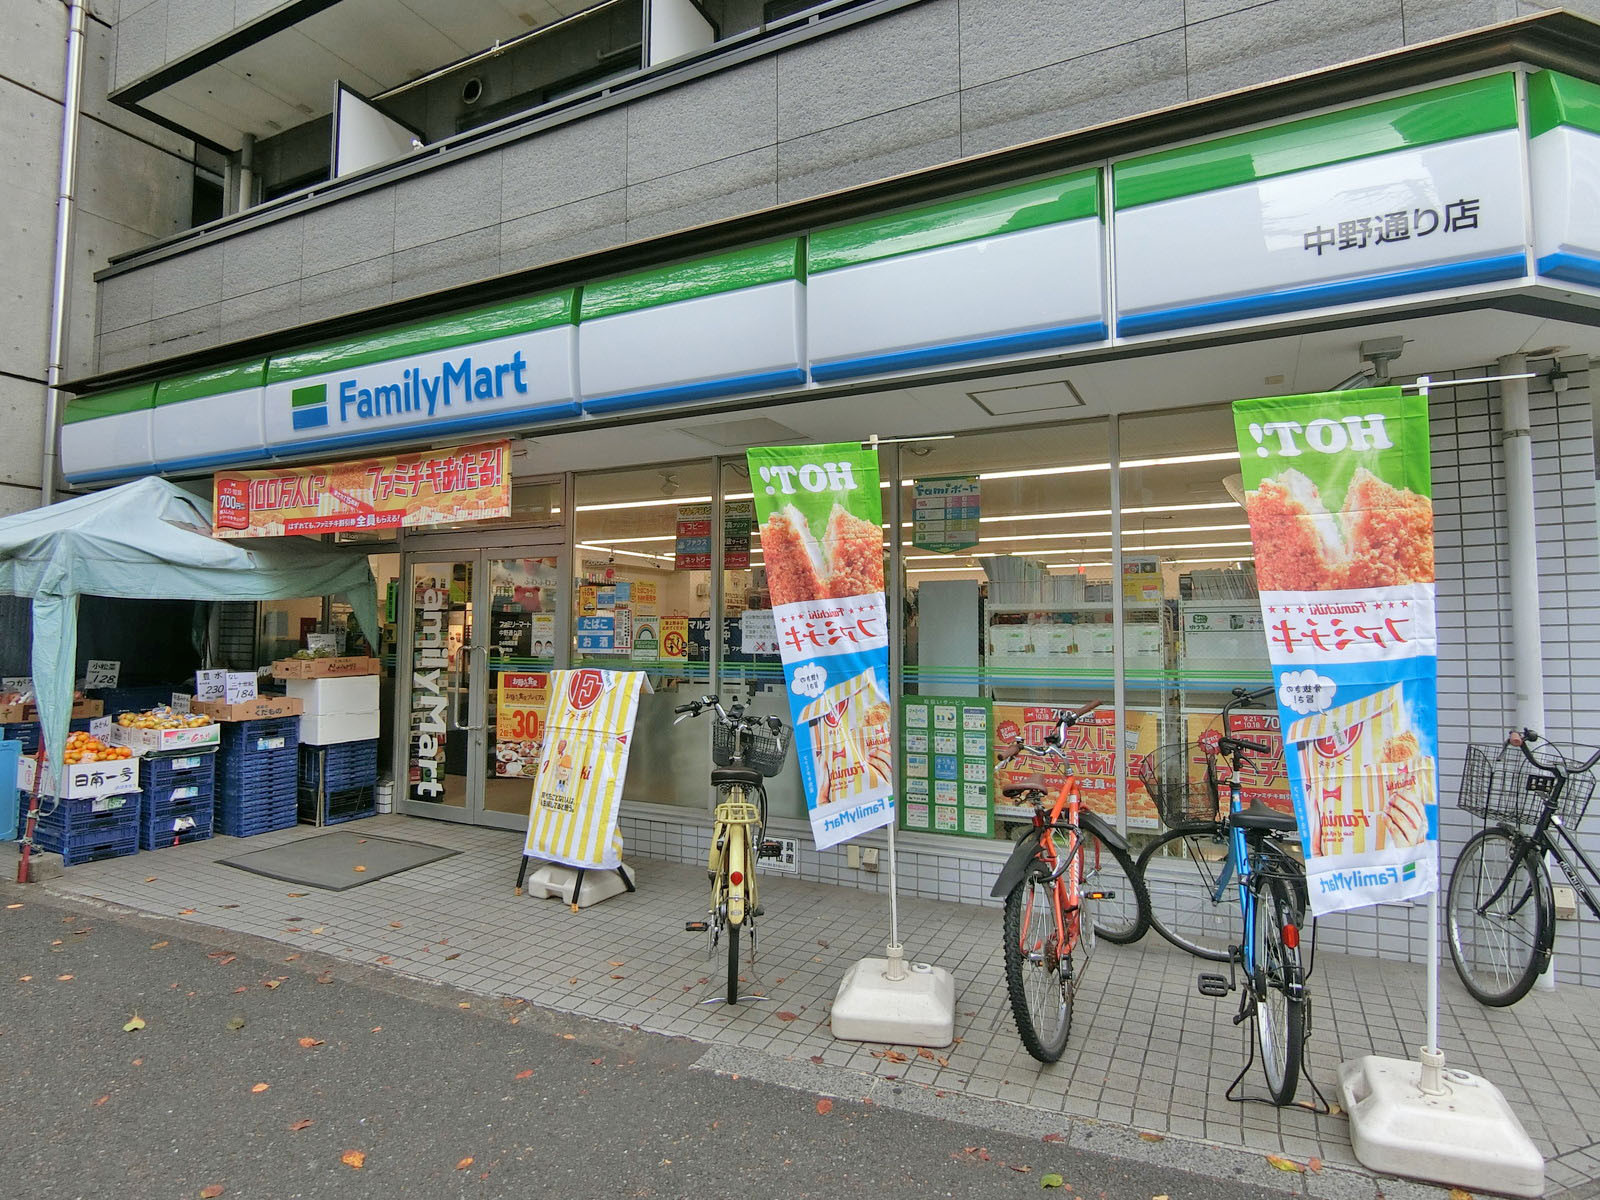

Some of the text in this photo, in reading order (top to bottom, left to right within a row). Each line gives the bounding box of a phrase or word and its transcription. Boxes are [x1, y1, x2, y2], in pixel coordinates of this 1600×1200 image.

[1303, 198, 1480, 256] 中野通り店
[339, 350, 528, 422] FamilyMart
[583, 618, 609, 630] たばこ
[205, 685, 225, 694] 230
[254, 707, 282, 716] くだもの
[512, 710, 538, 739] 30
[75, 767, 134, 789] 日南一号
